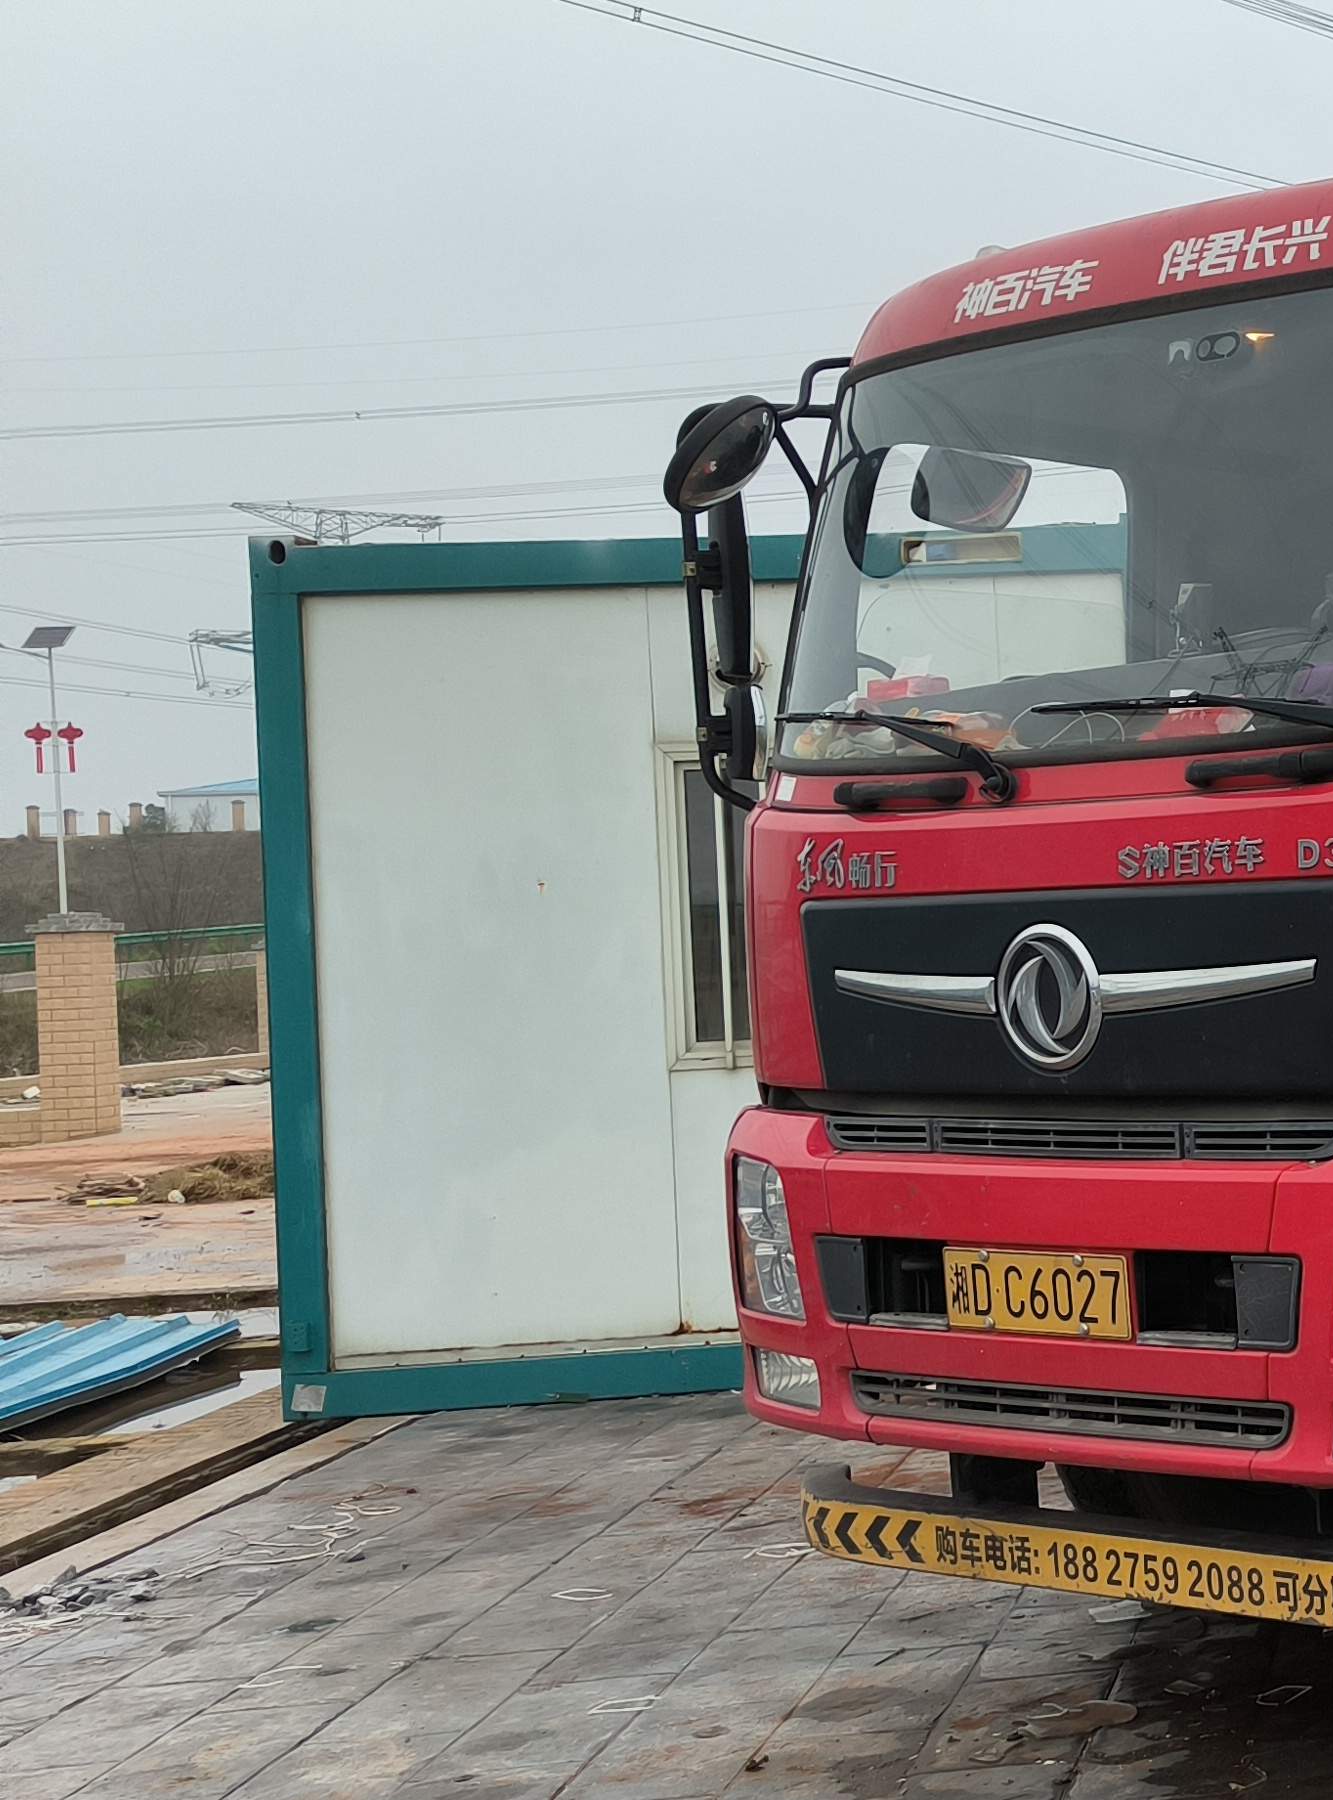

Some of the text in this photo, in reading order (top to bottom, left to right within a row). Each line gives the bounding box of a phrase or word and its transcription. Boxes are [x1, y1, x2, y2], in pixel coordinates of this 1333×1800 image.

[1158, 215, 1332, 285] 伴君长兴
[953, 259, 1099, 323] 神百汽车
[935, 1525, 1040, 1576] 购车电话:
[1048, 1542, 1098, 1582] 188
[1106, 1549, 1179, 1593] 2759
[1187, 1560, 1264, 1606] 2088
